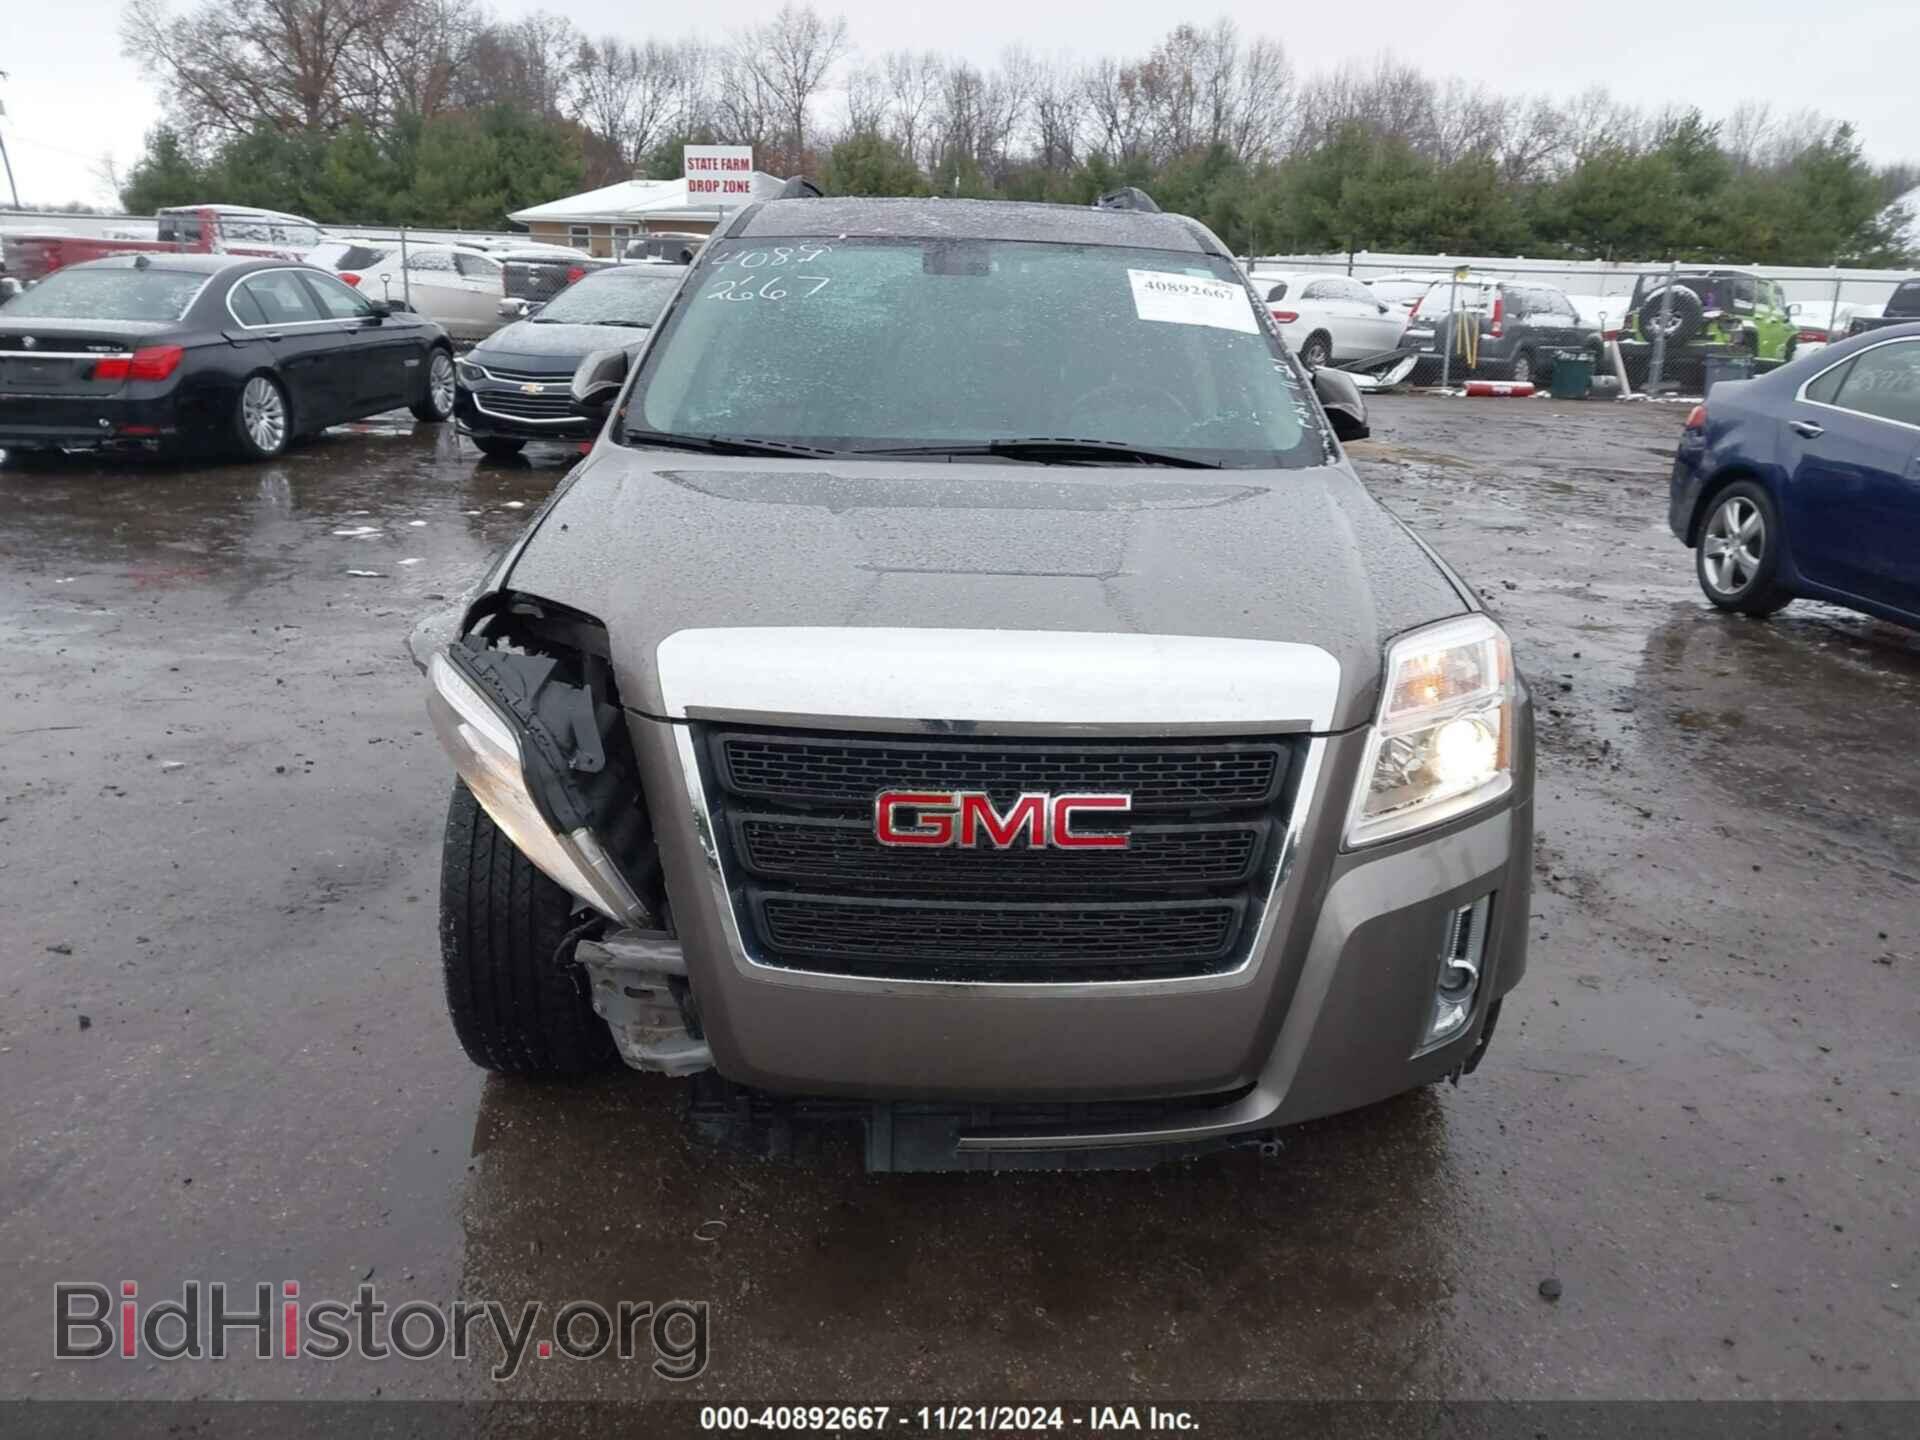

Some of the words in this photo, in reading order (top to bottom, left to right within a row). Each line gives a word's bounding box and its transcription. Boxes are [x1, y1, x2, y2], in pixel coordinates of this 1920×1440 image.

[687, 157, 718, 171] STATE
[721, 157, 750, 172] FARM
[688, 179, 720, 193] DROP
[723, 180, 751, 193] ZONE
[707, 275, 831, 301] 2667
[1144, 280, 1234, 301] 40892667
[876, 790, 1132, 849] GMC
